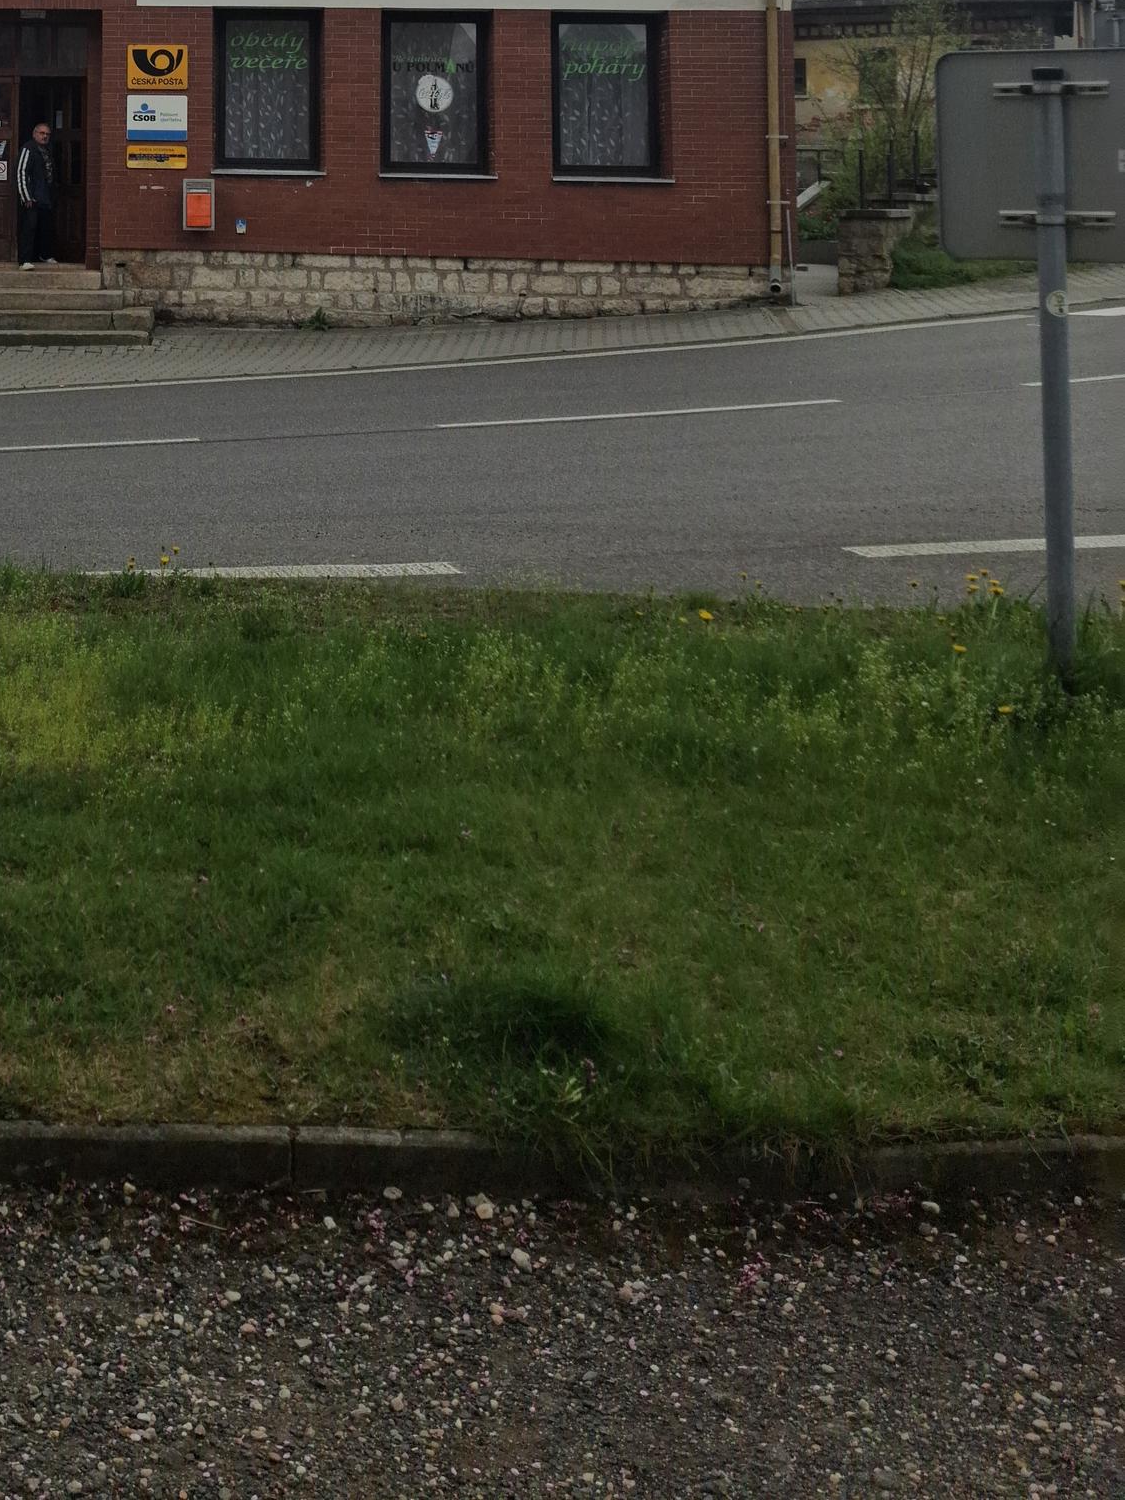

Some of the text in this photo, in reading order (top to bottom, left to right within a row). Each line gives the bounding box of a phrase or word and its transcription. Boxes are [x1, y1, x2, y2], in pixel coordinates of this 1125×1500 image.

[229, 53, 308, 70] večeře
[562, 57, 646, 82] poháry
[131, 77, 184, 86] ČESKÁ POŠTA
